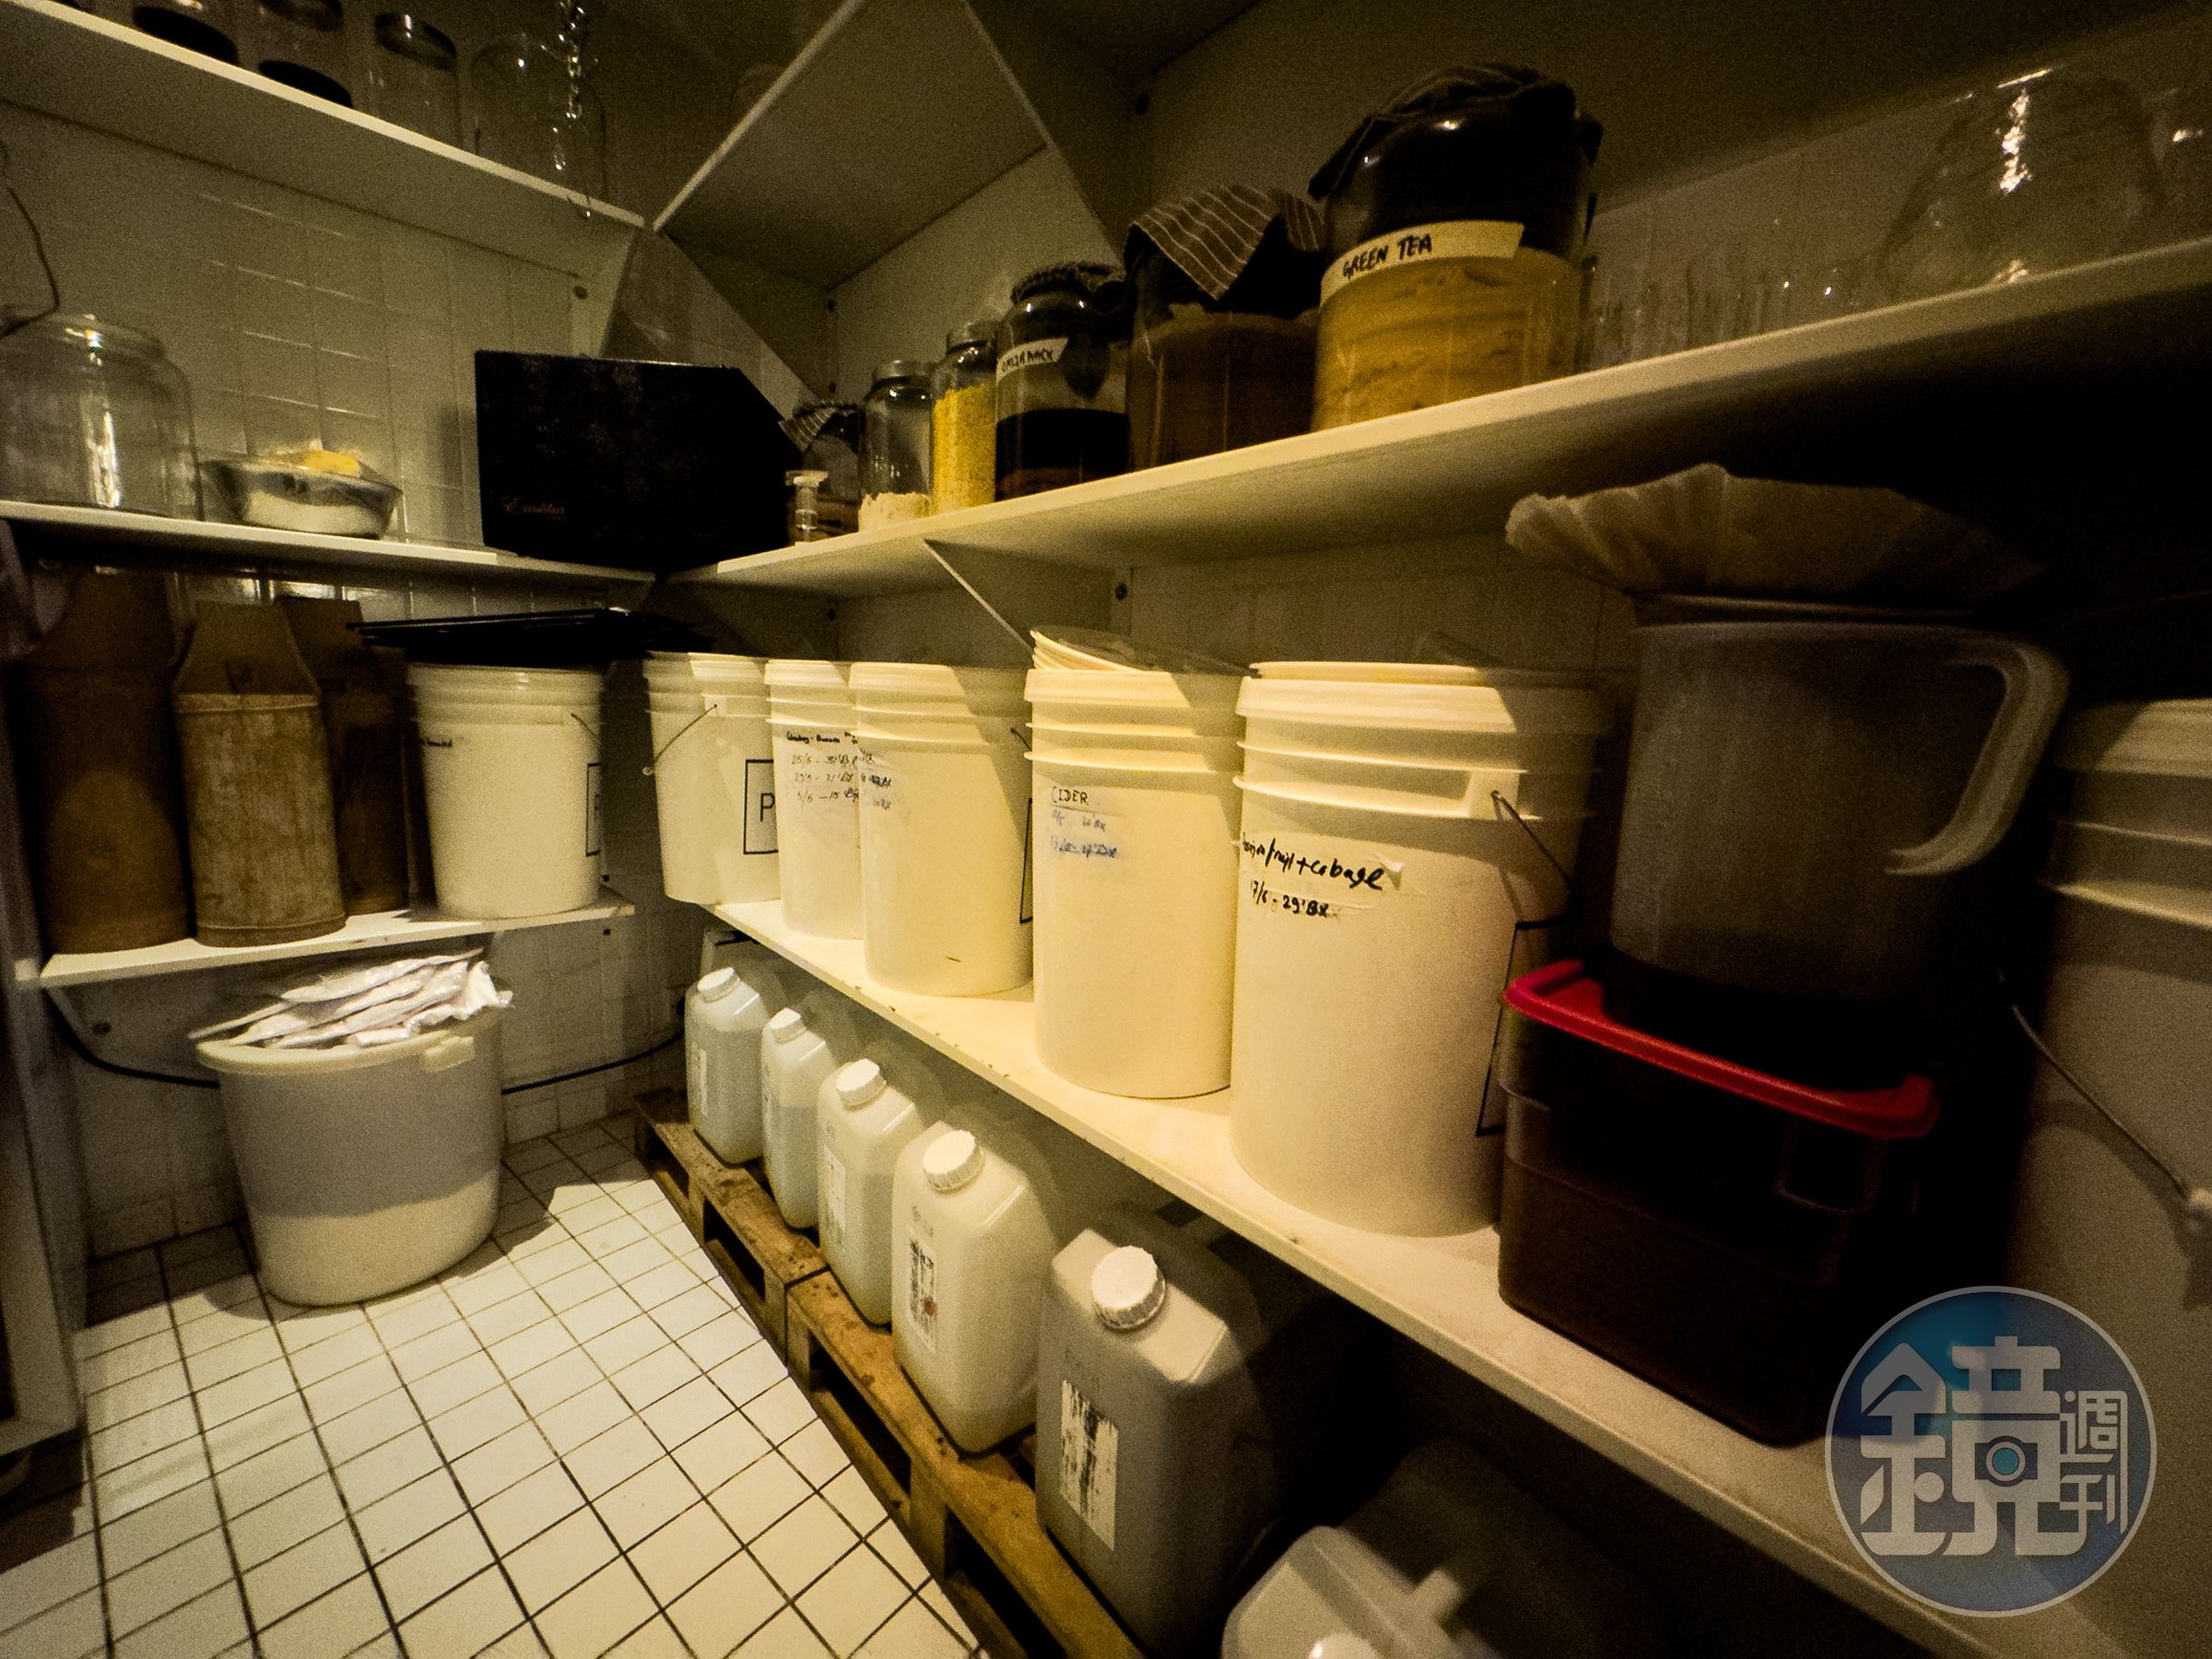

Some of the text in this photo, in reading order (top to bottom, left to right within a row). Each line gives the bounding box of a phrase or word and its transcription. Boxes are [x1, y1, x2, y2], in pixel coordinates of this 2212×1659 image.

[1342, 231, 1433, 280] GREEN TEA
[1052, 786, 1089, 806] CIDER
